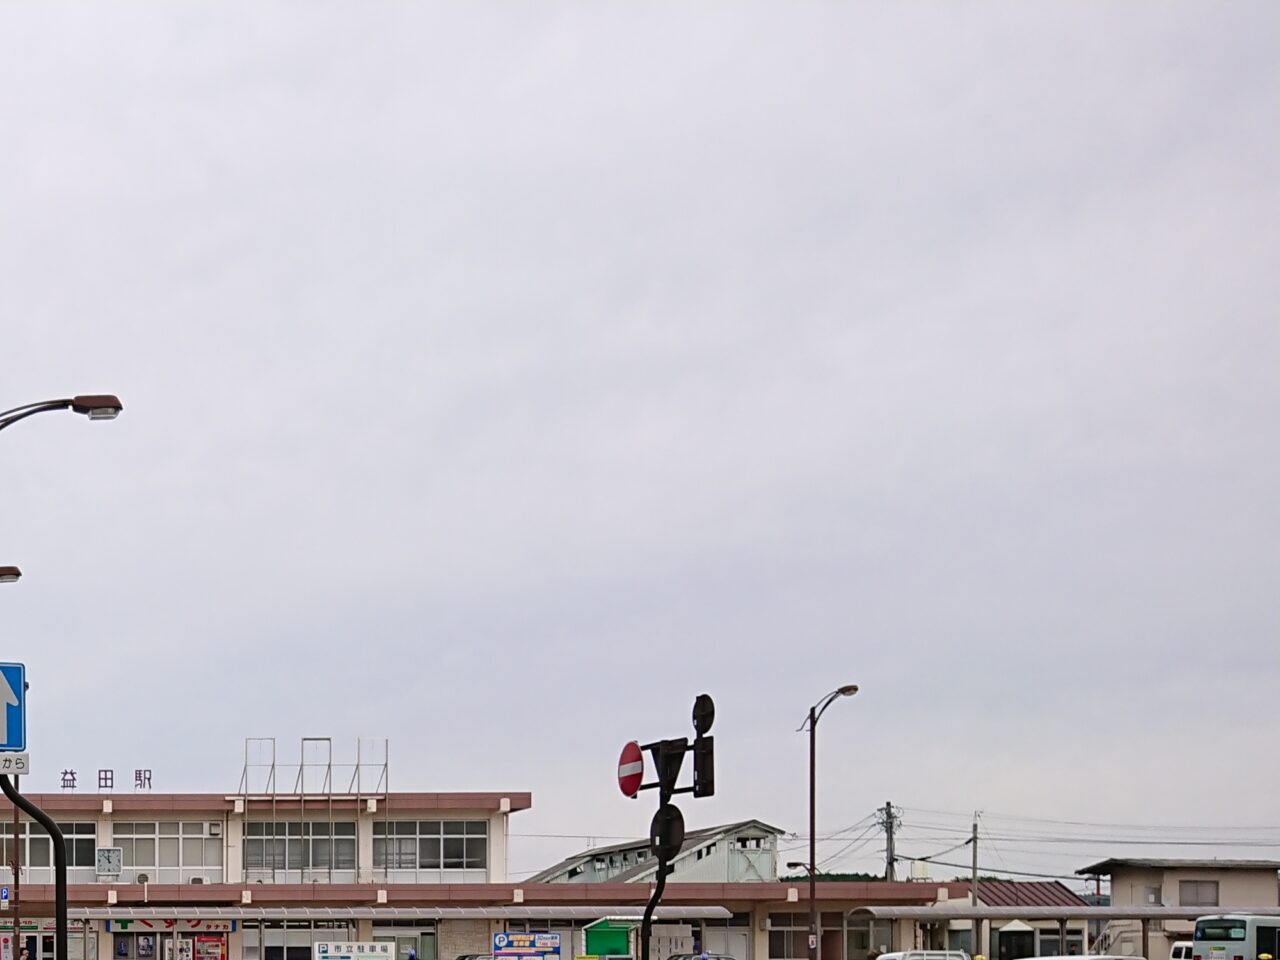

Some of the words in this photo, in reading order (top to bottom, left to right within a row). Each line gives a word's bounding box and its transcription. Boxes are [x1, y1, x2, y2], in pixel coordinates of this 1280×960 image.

[61, 769, 152, 789] 益田駅
[334, 944, 389, 953] 市立駐車場
